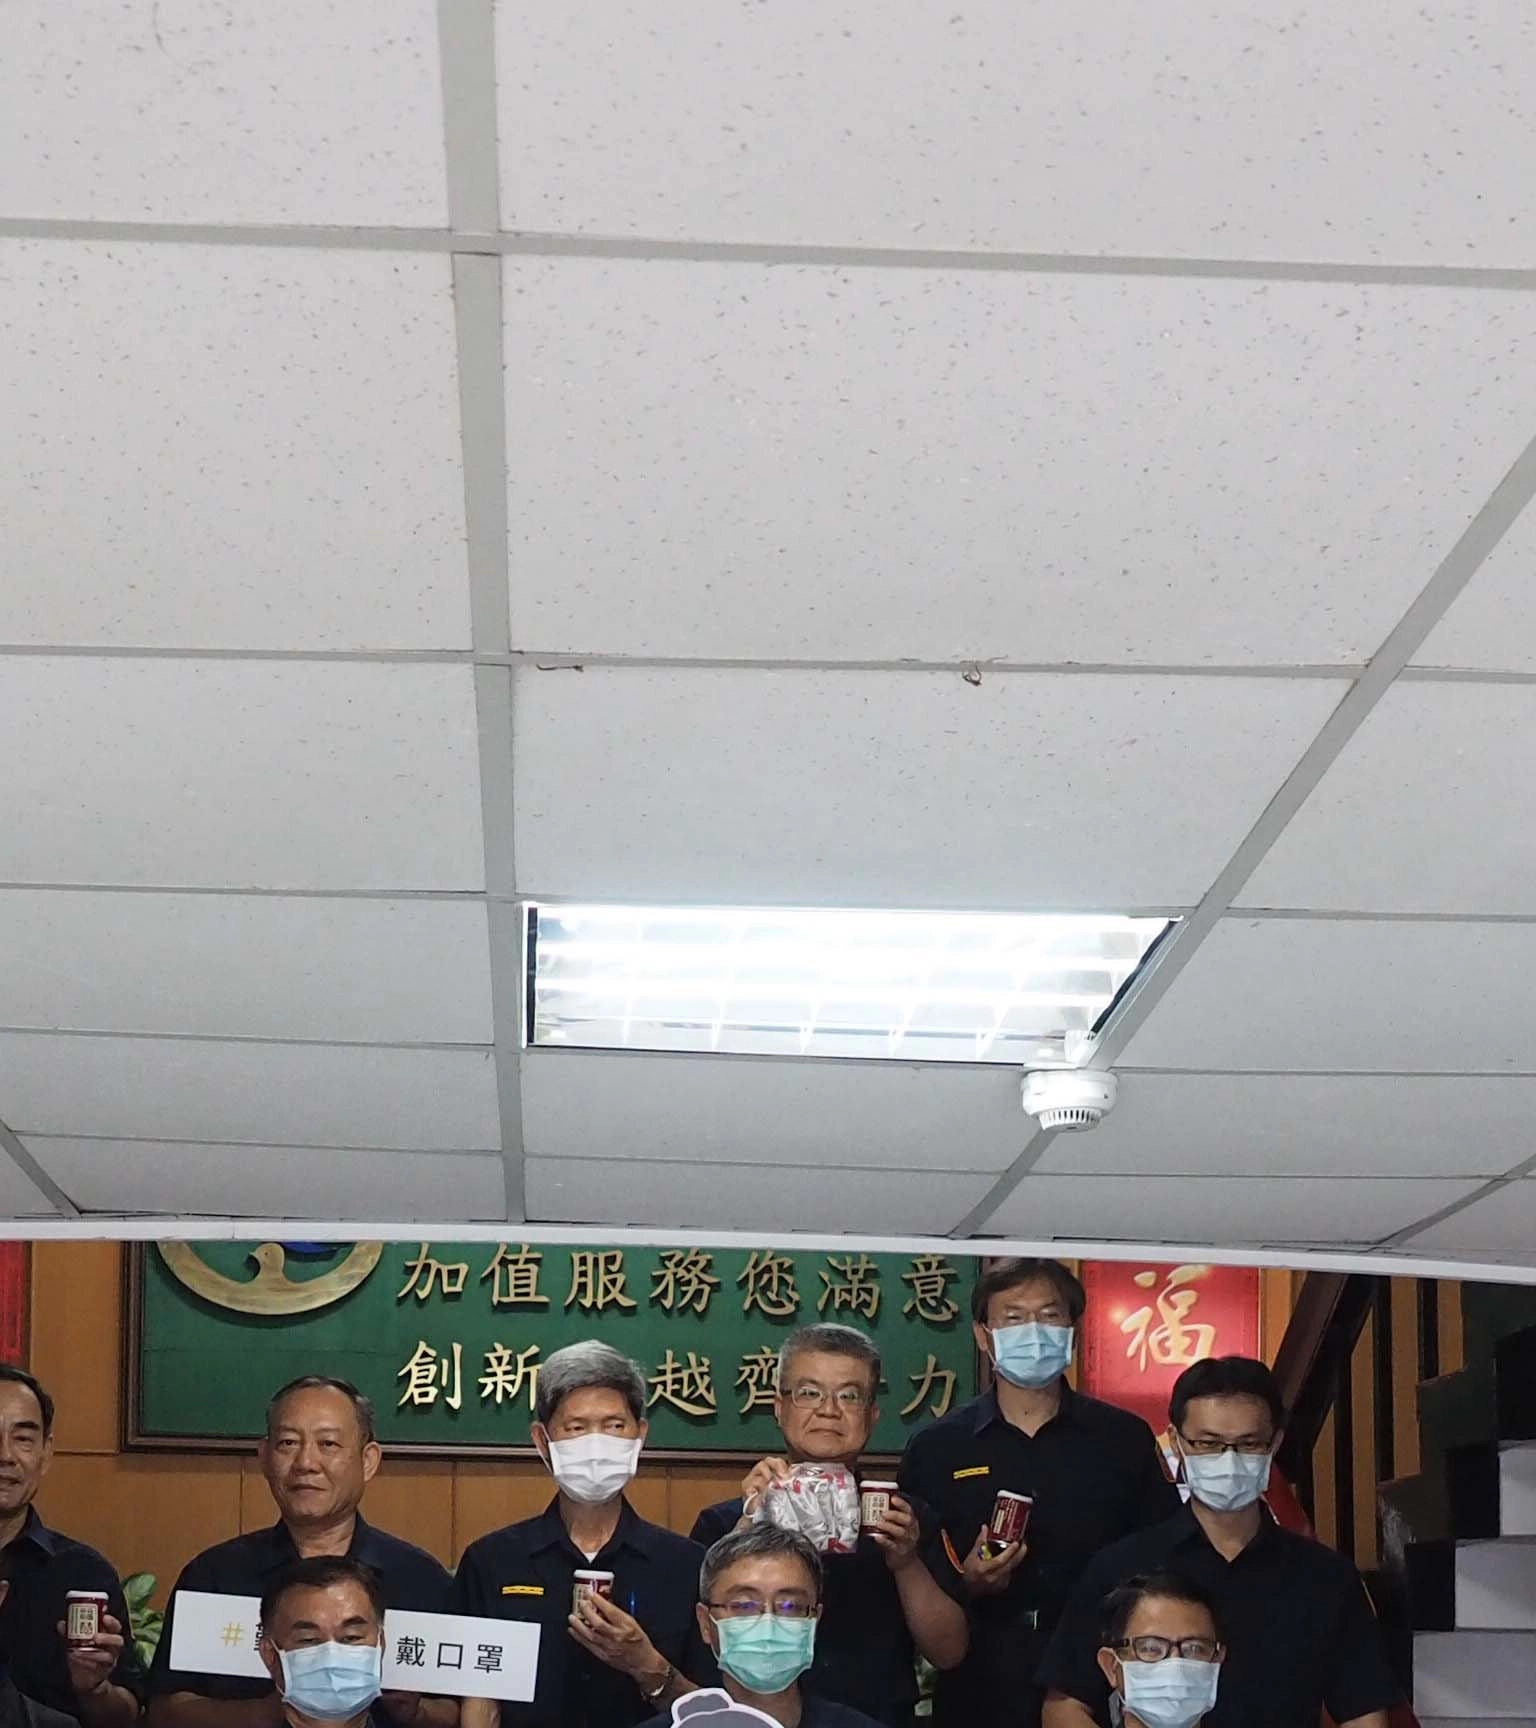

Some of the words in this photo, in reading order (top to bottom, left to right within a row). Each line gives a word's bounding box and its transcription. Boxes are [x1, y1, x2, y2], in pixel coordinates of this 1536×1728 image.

[396, 1241, 962, 1323] 加值服務您滿意
[1119, 1263, 1216, 1373] 福
[396, 1336, 960, 1420] 創新越齊力
[395, 1634, 505, 1674] 戴口罩
